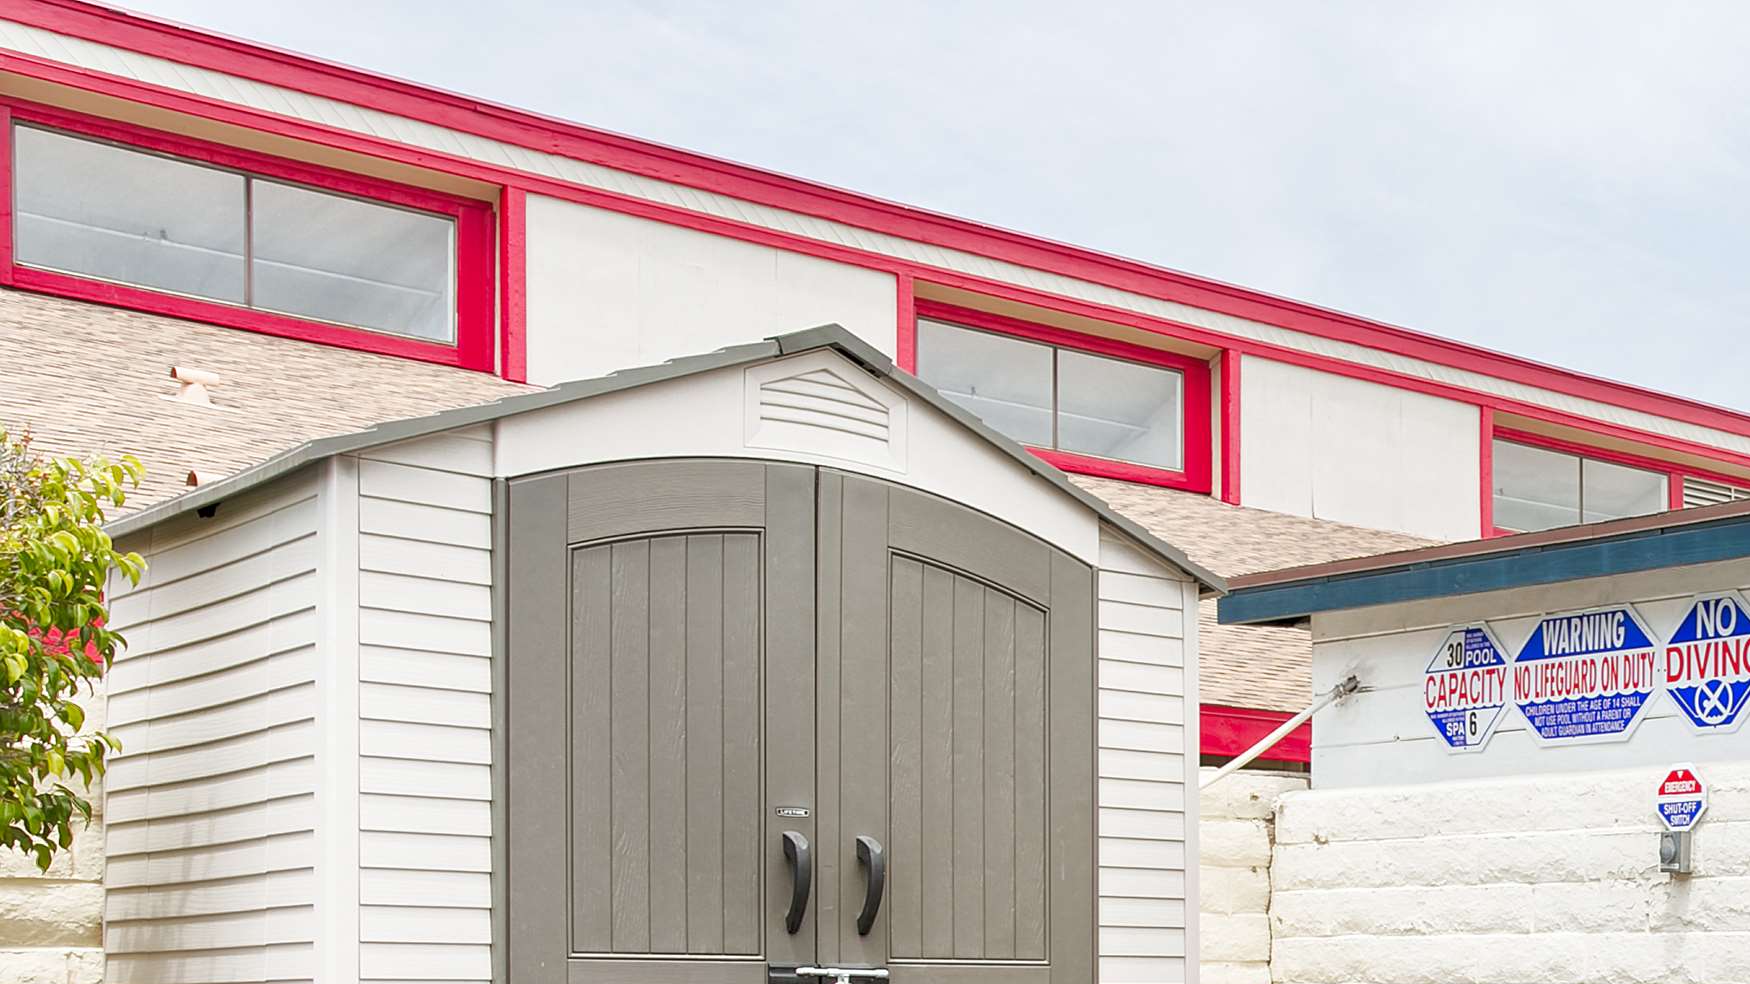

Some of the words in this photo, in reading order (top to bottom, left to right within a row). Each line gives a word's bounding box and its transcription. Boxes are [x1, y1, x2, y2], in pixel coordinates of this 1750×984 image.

[1696, 597, 1737, 639] NO
[1542, 612, 1625, 656] WARNING
[1447, 642, 1463, 667] 30
[1465, 649, 1497, 666] POOL
[1514, 665, 1531, 700] NO
[1535, 658, 1597, 699] LIFEGUARD
[1601, 655, 1619, 692] ON
[1623, 651, 1656, 690] DUTY
[1425, 667, 1507, 708] CAPACITY
[1525, 705, 1555, 717] CHILDREN
[1555, 702, 1577, 714] UNDER
[1577, 701, 1589, 712] THE
[1589, 700, 1602, 711] AGE
[1602, 698, 1612, 710] OF
[1612, 698, 1620, 708] 14
[1621, 696, 1641, 708] SHALL
[1446, 722, 1465, 737] SPA
[1469, 711, 1477, 736] 6
[1557, 713, 1571, 725] POOL
[1663, 802, 1697, 815] SHUT-OFF
[1670, 814, 1690, 826] SWITCH
